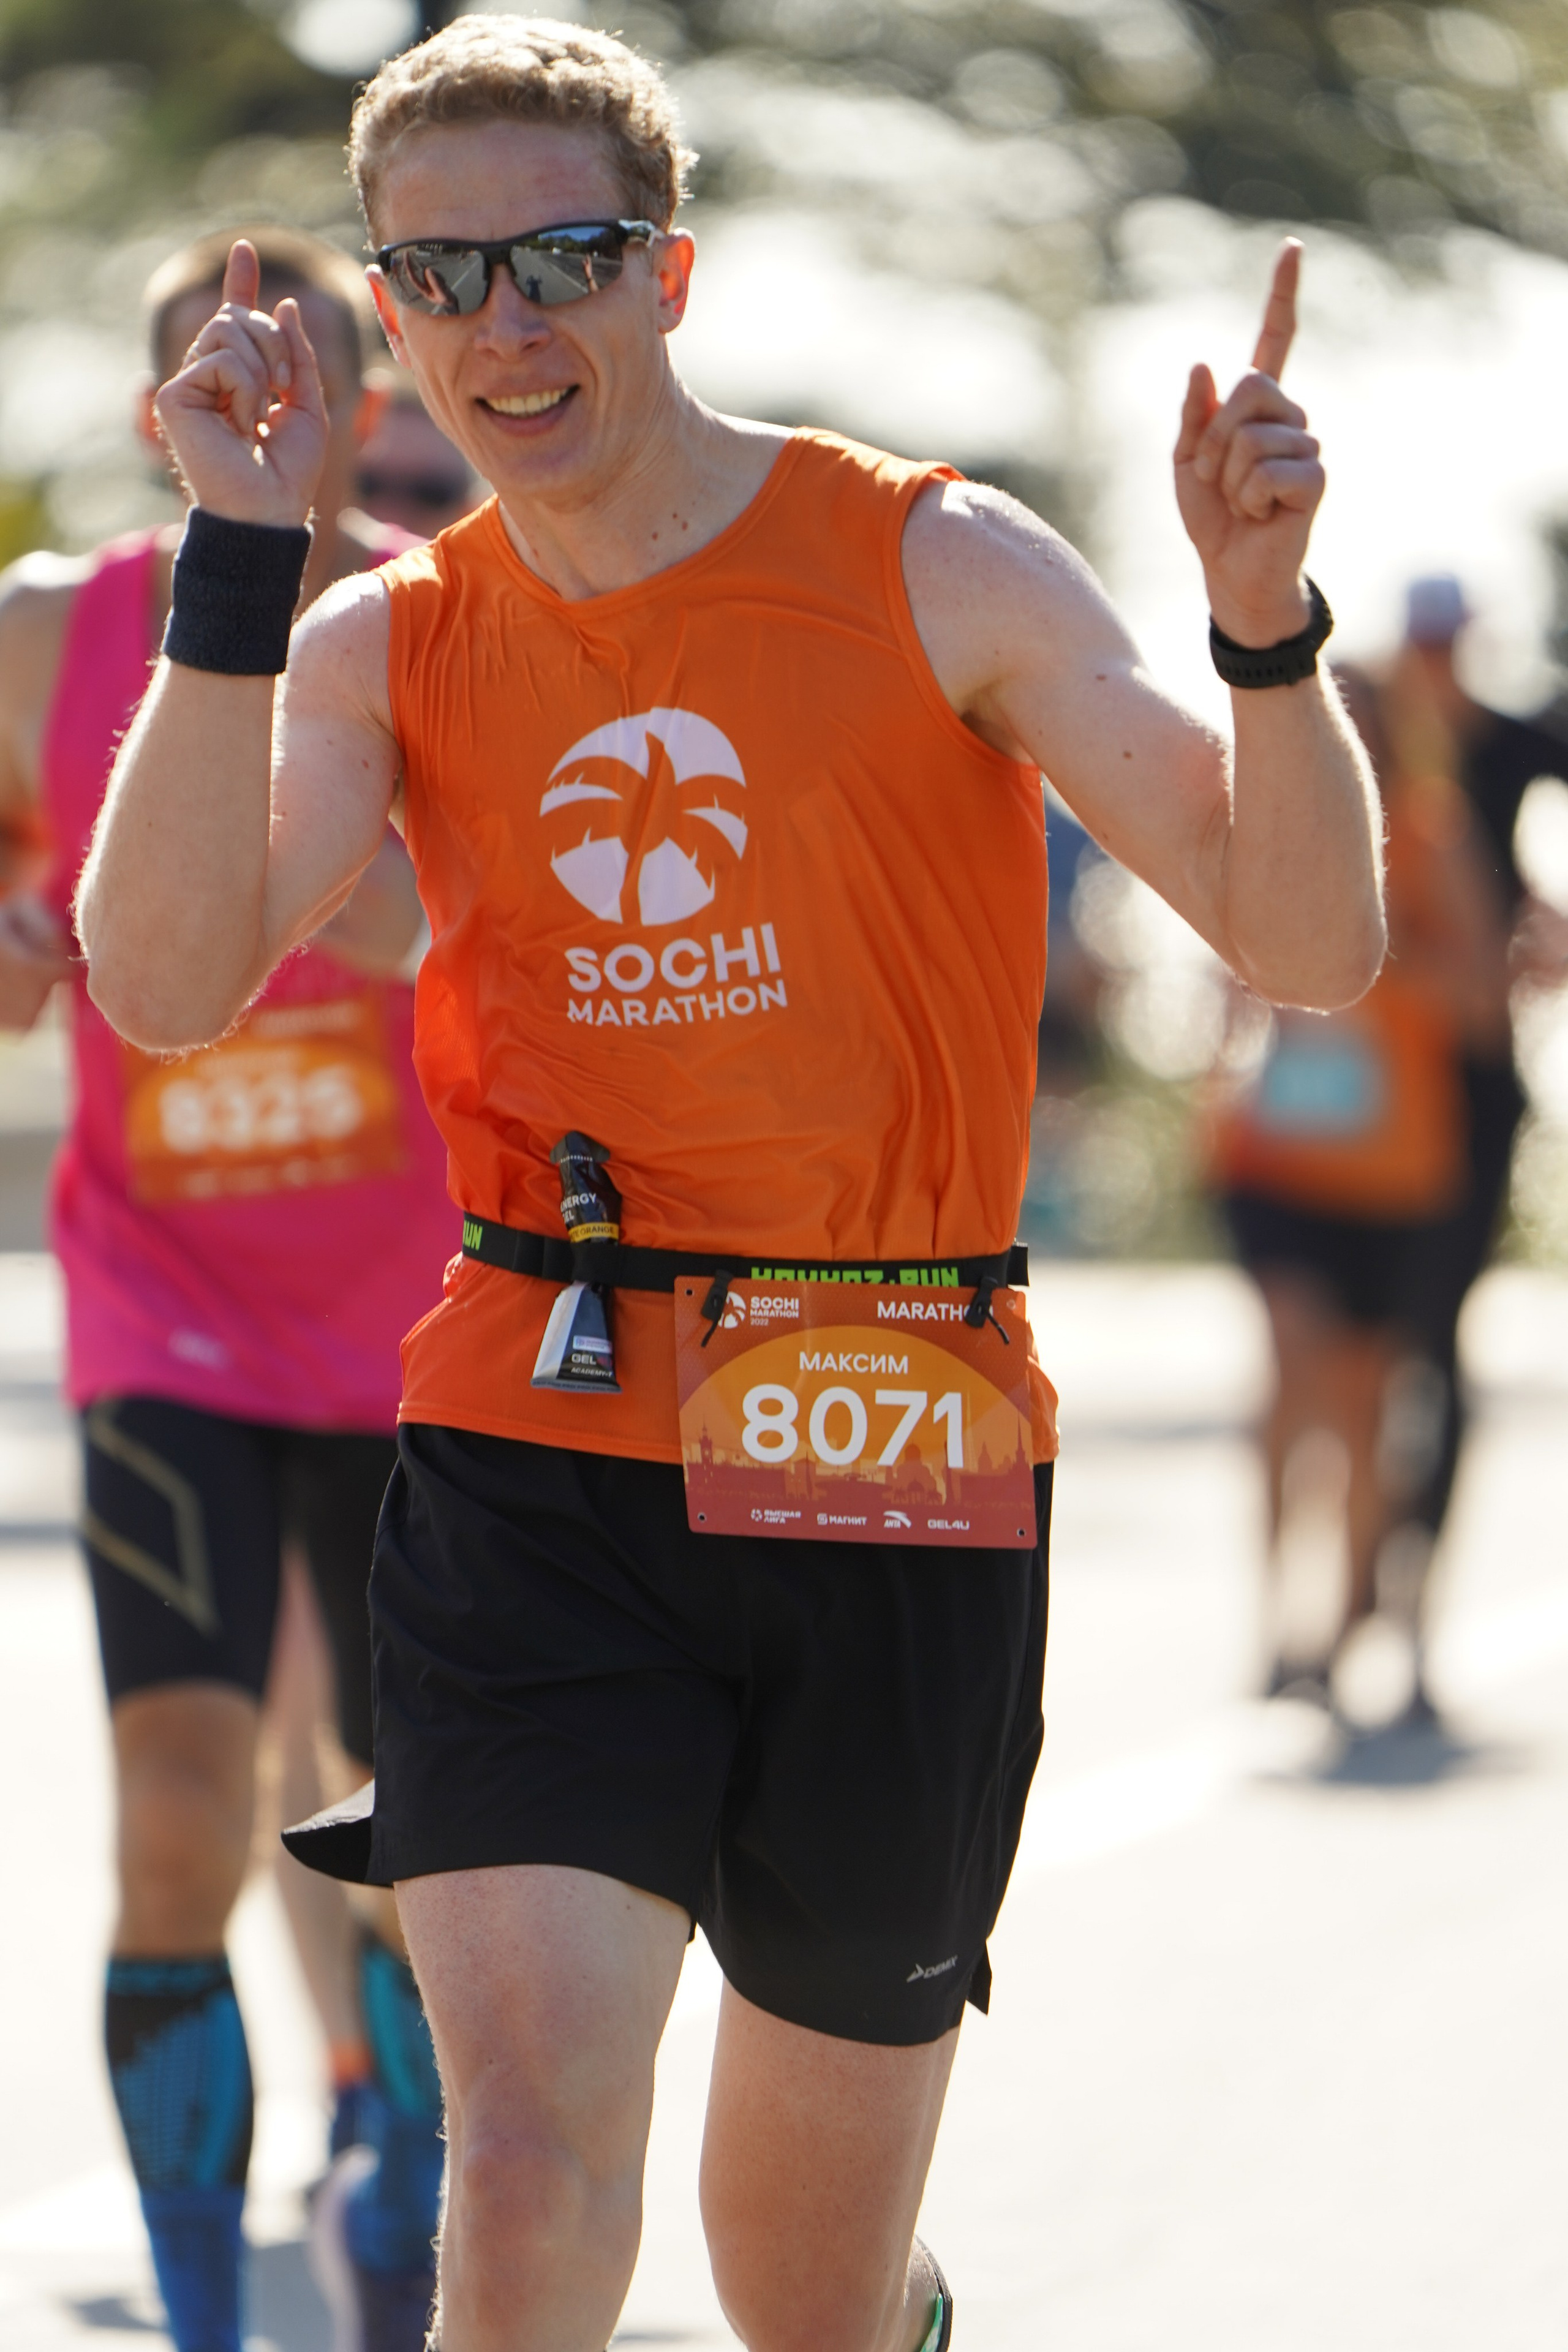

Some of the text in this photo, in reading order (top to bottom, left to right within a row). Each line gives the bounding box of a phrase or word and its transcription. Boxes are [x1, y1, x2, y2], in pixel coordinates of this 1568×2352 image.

[564, 922, 781, 993] SOCHI
[567, 979, 788, 1027] MARATHON
[750, 1296, 799, 1310] SOCHI
[750, 1309, 799, 1318] MARATHON
[877, 1300, 993, 1321] MARATH
[799, 1351, 908, 1374] МАКСИМ
[742, 1383, 964, 1469] 8071
[764, 1509, 801, 1518] ВЫСШАЯ
[829, 1515, 867, 1526] МАГНИТ
[884, 1519, 901, 1529] ANTA
[927, 1519, 970, 1530] GEL4U
